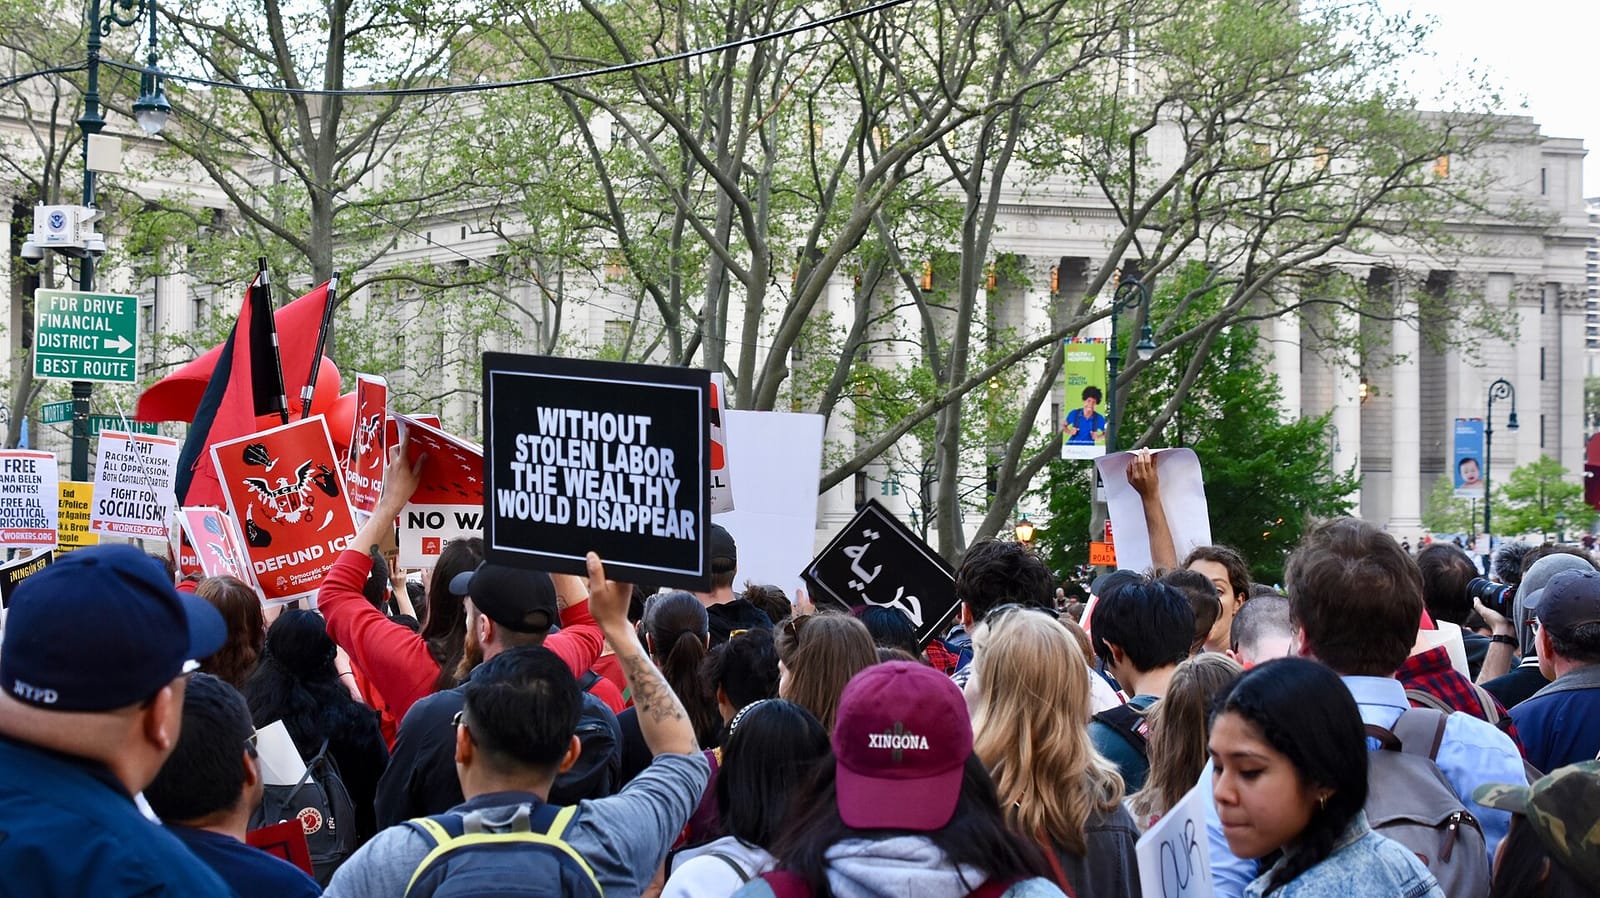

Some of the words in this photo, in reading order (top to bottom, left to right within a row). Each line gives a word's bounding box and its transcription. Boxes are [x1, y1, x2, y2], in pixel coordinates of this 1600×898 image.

[50, 296, 78, 312] FDR
[83, 298, 124, 315] DRIVE
[39, 313, 113, 332] FINANCIAL
[39, 332, 99, 350] DISTRICT
[43, 358, 78, 374] BEST
[83, 360, 128, 377] ROUTE
[44, 402, 64, 422] WORTH
[65, 403, 73, 412] ST
[537, 407, 651, 445] WITHOUT
[515, 433, 596, 469] STOLEN
[602, 442, 675, 478] LABOR
[4, 459, 36, 473] FREE
[104, 461, 118, 471] ALL
[18, 475, 42, 484] BELEN
[102, 471, 118, 483] BOTH
[118, 473, 148, 486] CAPITALIST
[510, 461, 557, 495] THE
[563, 468, 681, 508] WEALTHY
[2, 484, 39, 494] MONTES!
[63, 489, 75, 498] End
[111, 488, 138, 501] FIGHT
[139, 491, 158, 503] FOR
[1, 497, 24, 508] FREE
[25, 498, 42, 508] ALL
[99, 499, 167, 521] SOCIALISM!
[65, 511, 91, 521] Agains
[408, 511, 445, 530] NO
[497, 488, 570, 524] WOULD
[576, 498, 696, 541] DISAPPEAR
[0, 518, 49, 529] RISONERS!
[70, 523, 89, 532] Brow
[112, 523, 163, 535] WORKERS.ORG
[4, 532, 53, 541] WORKERS.ORG
[58, 533, 79, 543] eople
[37, 558, 47, 571] SER
[253, 544, 324, 575] DEFUND
[289, 567, 322, 581] Democratic
[298, 573, 322, 585] America
[14, 679, 58, 703] NYPD
[868, 733, 930, 750] XINGONA
